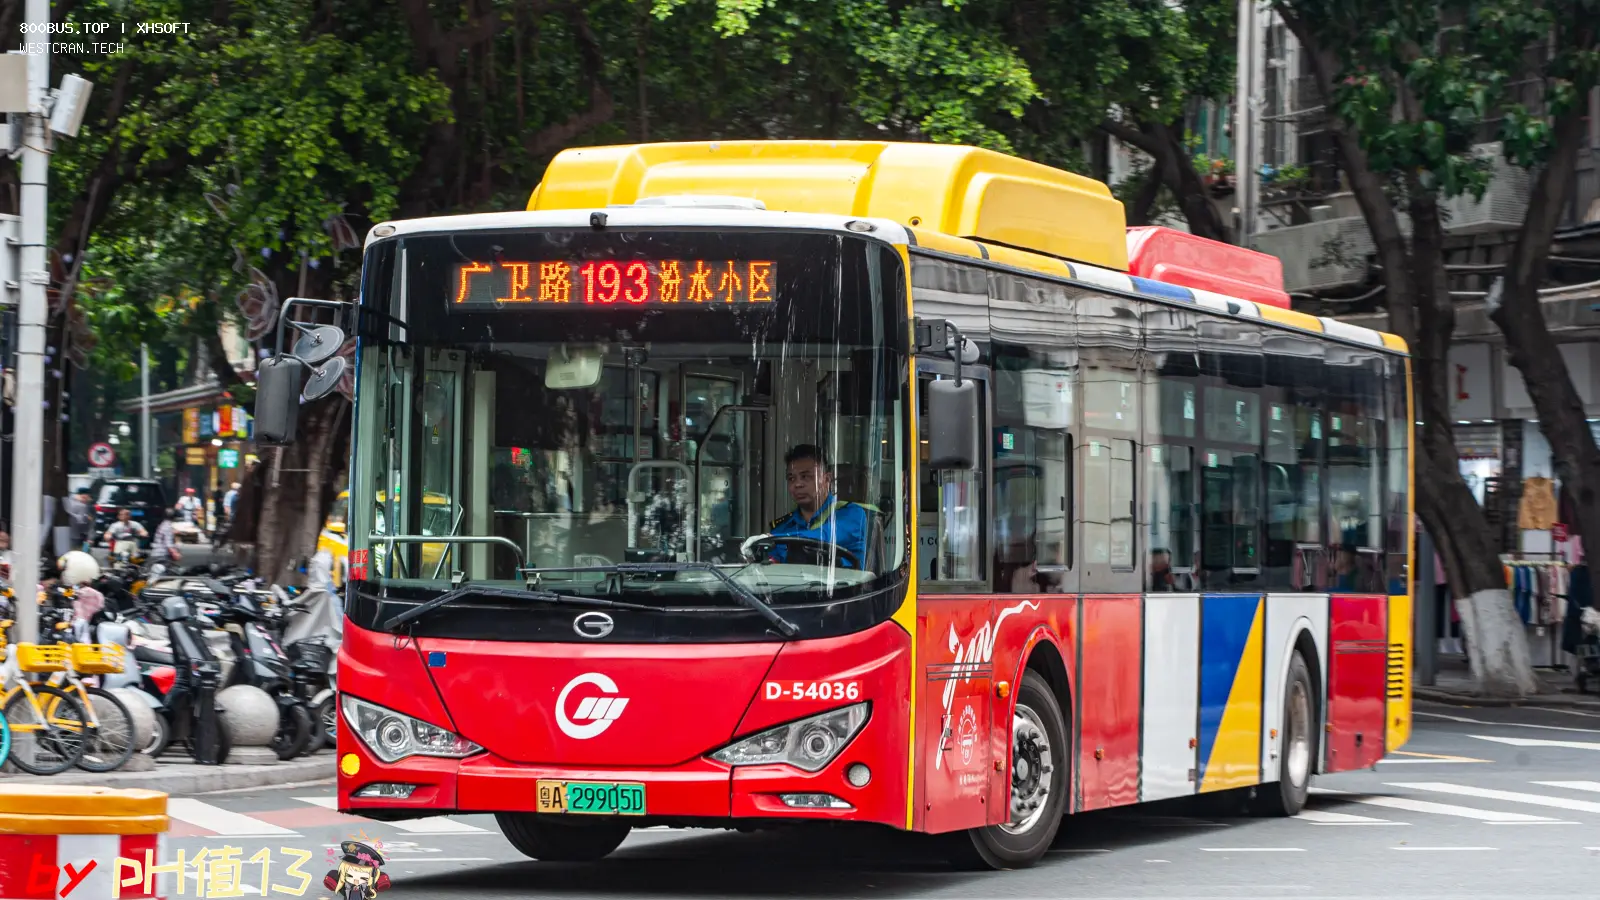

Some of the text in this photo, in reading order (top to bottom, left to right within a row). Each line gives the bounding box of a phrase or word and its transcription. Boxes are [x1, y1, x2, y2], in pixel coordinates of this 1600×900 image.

[456, 260, 572, 303] 广卫路
[580, 262, 649, 303] 193
[765, 681, 860, 700] D-54036
